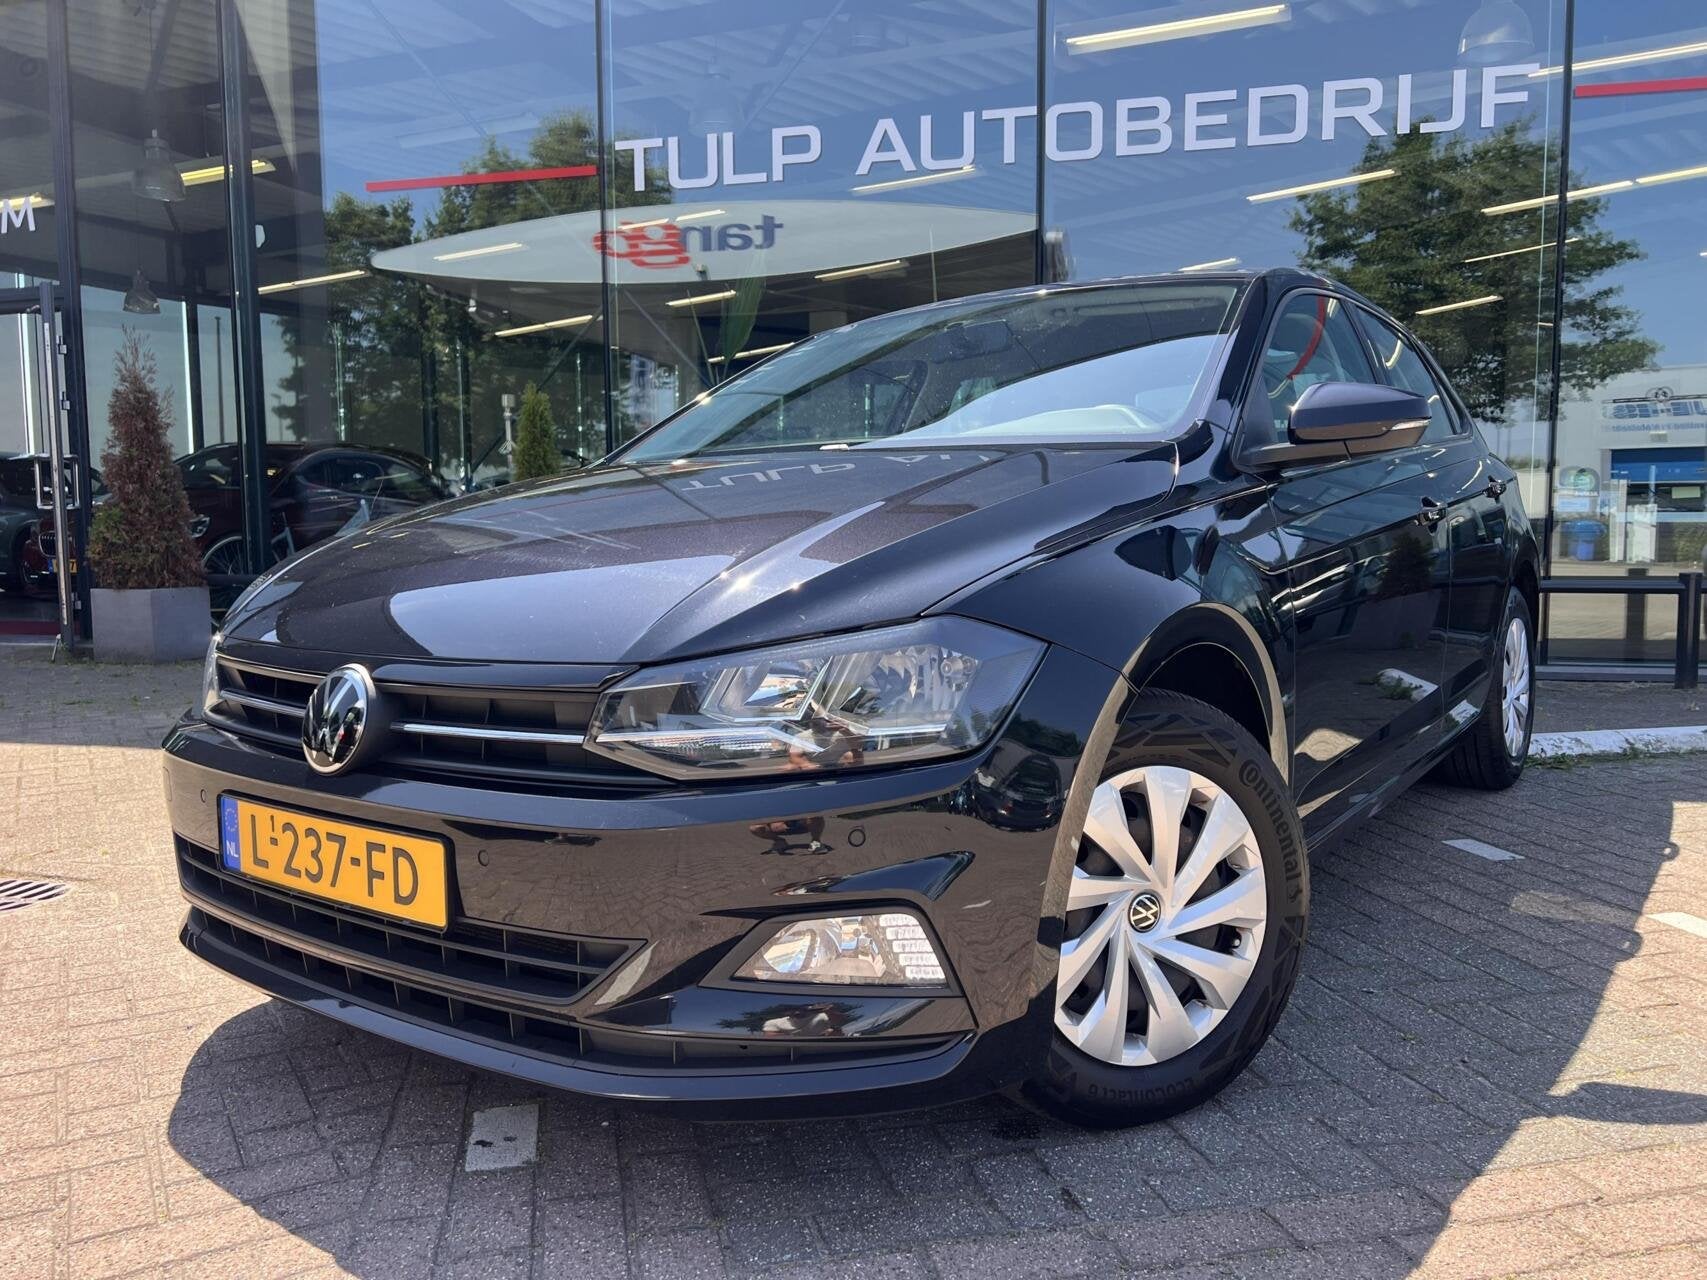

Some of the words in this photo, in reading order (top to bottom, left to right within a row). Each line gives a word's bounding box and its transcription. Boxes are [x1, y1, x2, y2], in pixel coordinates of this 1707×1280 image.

[615, 125, 821, 191] TULP
[855, 63, 1541, 175] AUTOBEDRIJF
[226, 840, 239, 858] NL
[1239, 759, 1304, 882] Continental
